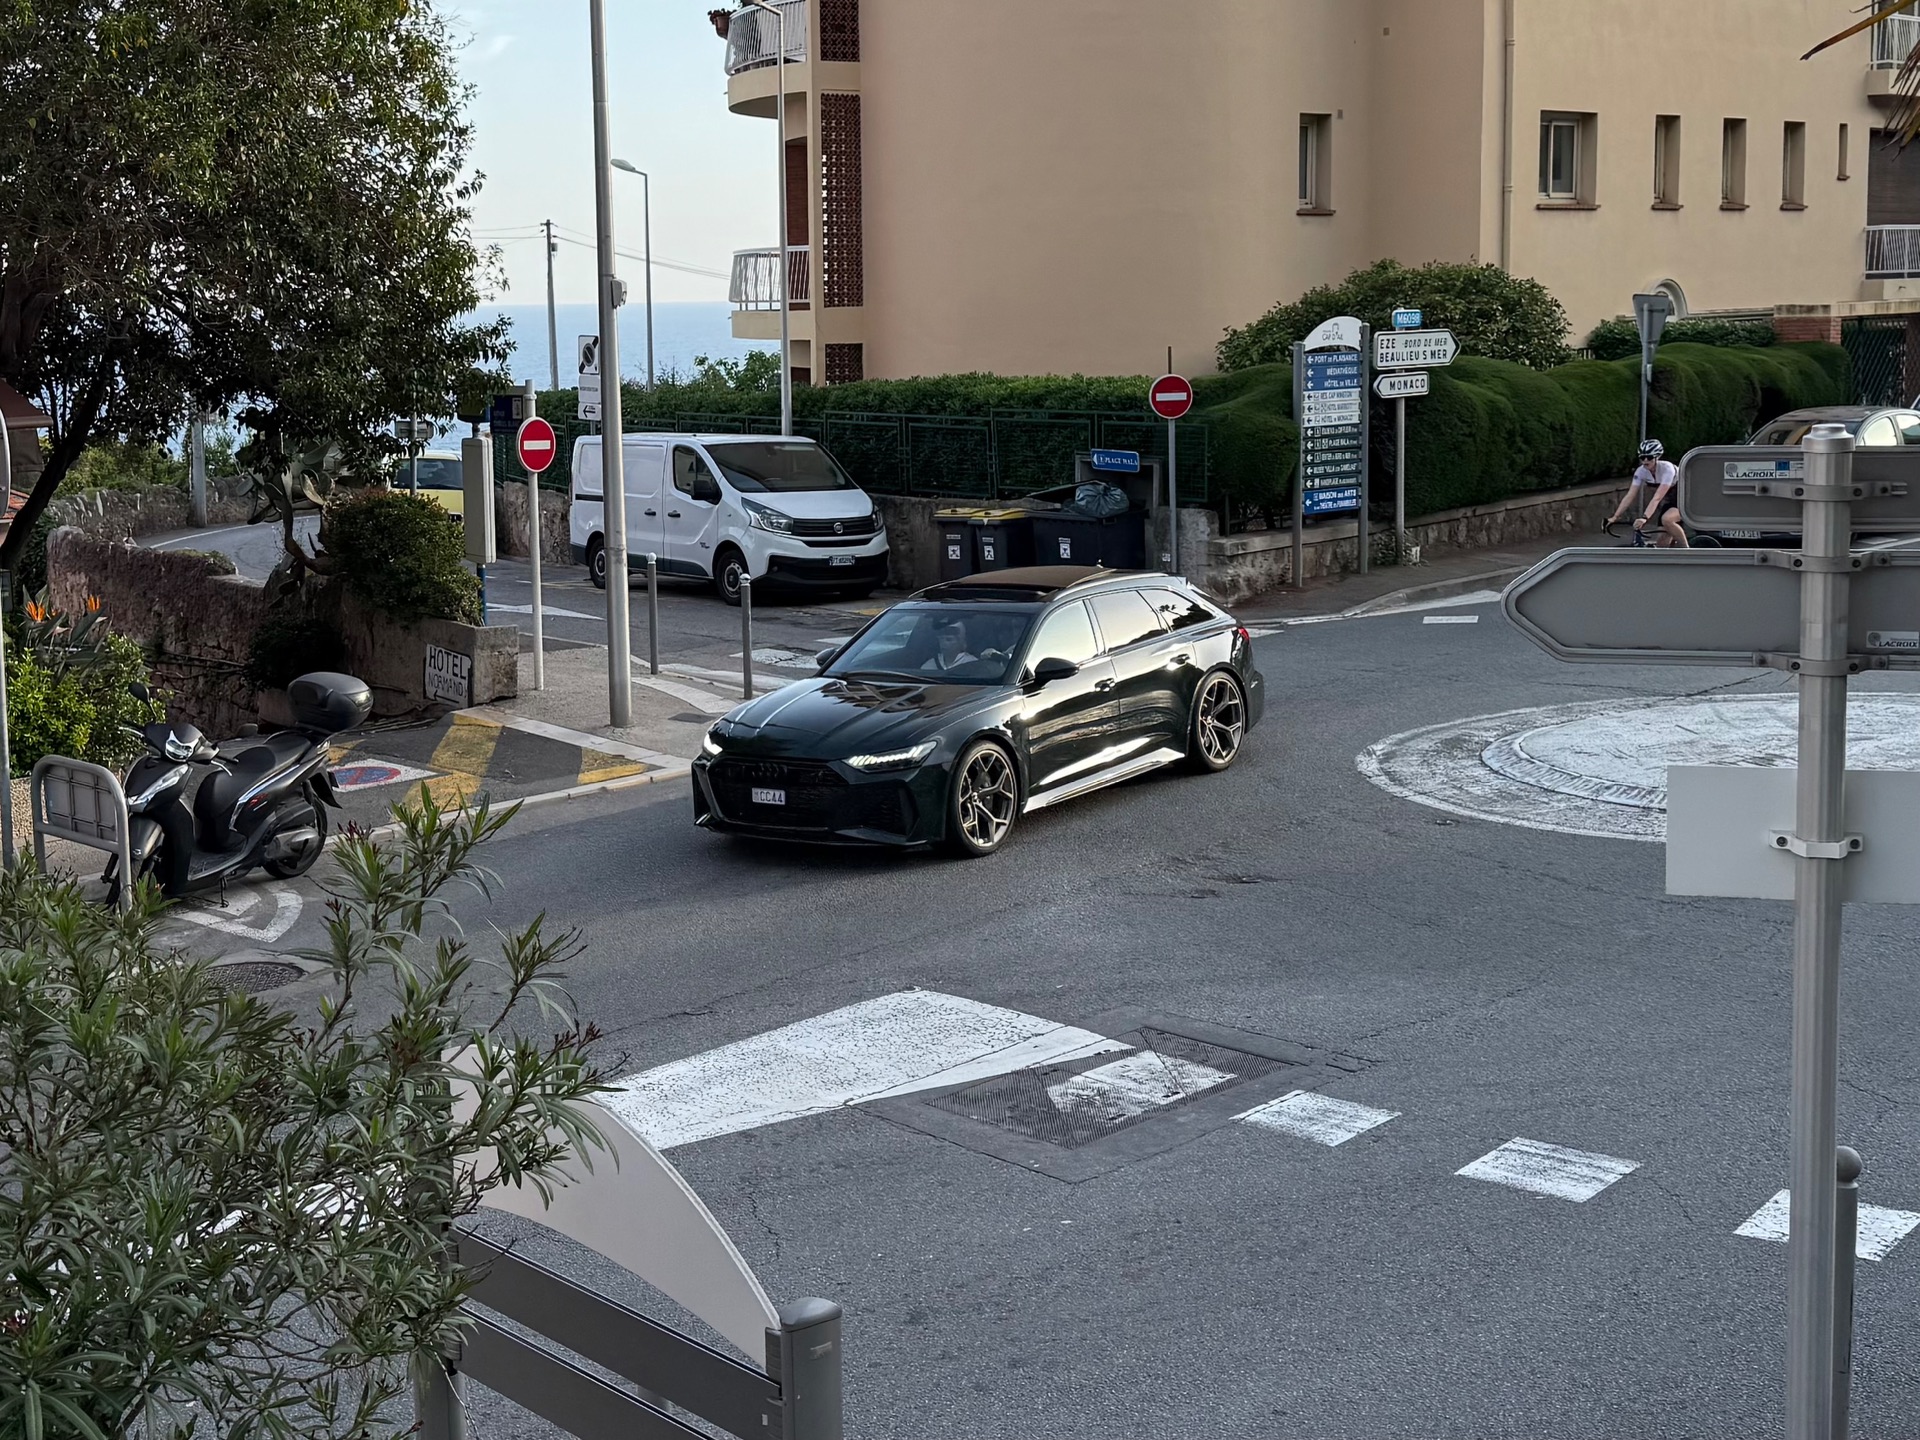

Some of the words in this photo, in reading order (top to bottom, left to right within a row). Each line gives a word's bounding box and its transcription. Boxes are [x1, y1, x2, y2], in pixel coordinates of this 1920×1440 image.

[1397, 313, 1420, 324] M6098
[1380, 338, 1396, 349] EZE
[1424, 338, 1432, 347] DE
[1434, 337, 1447, 346] MER
[1314, 355, 1327, 363] PORT
[1332, 354, 1358, 362] PLAISANCE
[1379, 350, 1420, 363] BEAULIEU
[1423, 350, 1427, 360] S
[1430, 349, 1447, 360] MER
[1345, 378, 1358, 387] VILLE
[1389, 378, 1426, 391] MONACO
[429, 646, 467, 680] HOTEL
